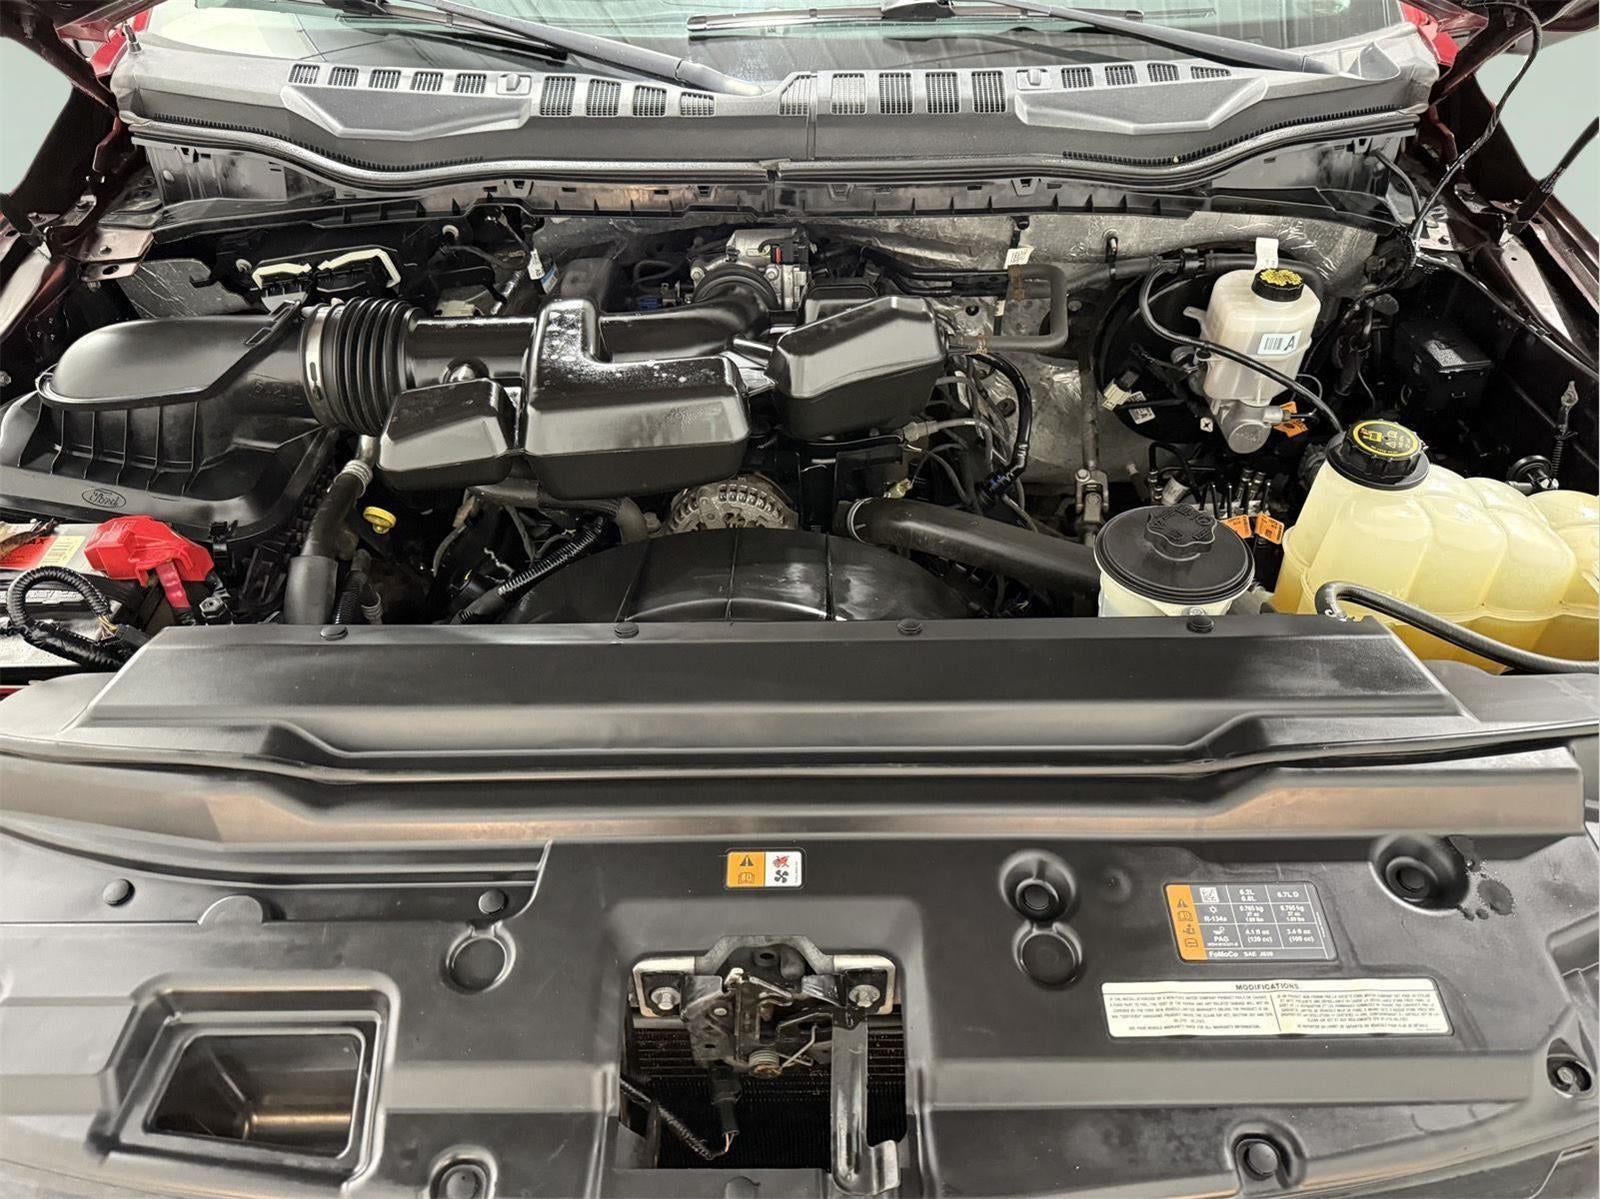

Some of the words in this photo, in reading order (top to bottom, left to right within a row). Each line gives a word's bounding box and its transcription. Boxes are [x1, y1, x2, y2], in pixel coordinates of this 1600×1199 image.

[1283, 335, 1295, 351] A
[89, 488, 120, 506] Ford
[1235, 983, 1300, 991] MODIFICATIONS
